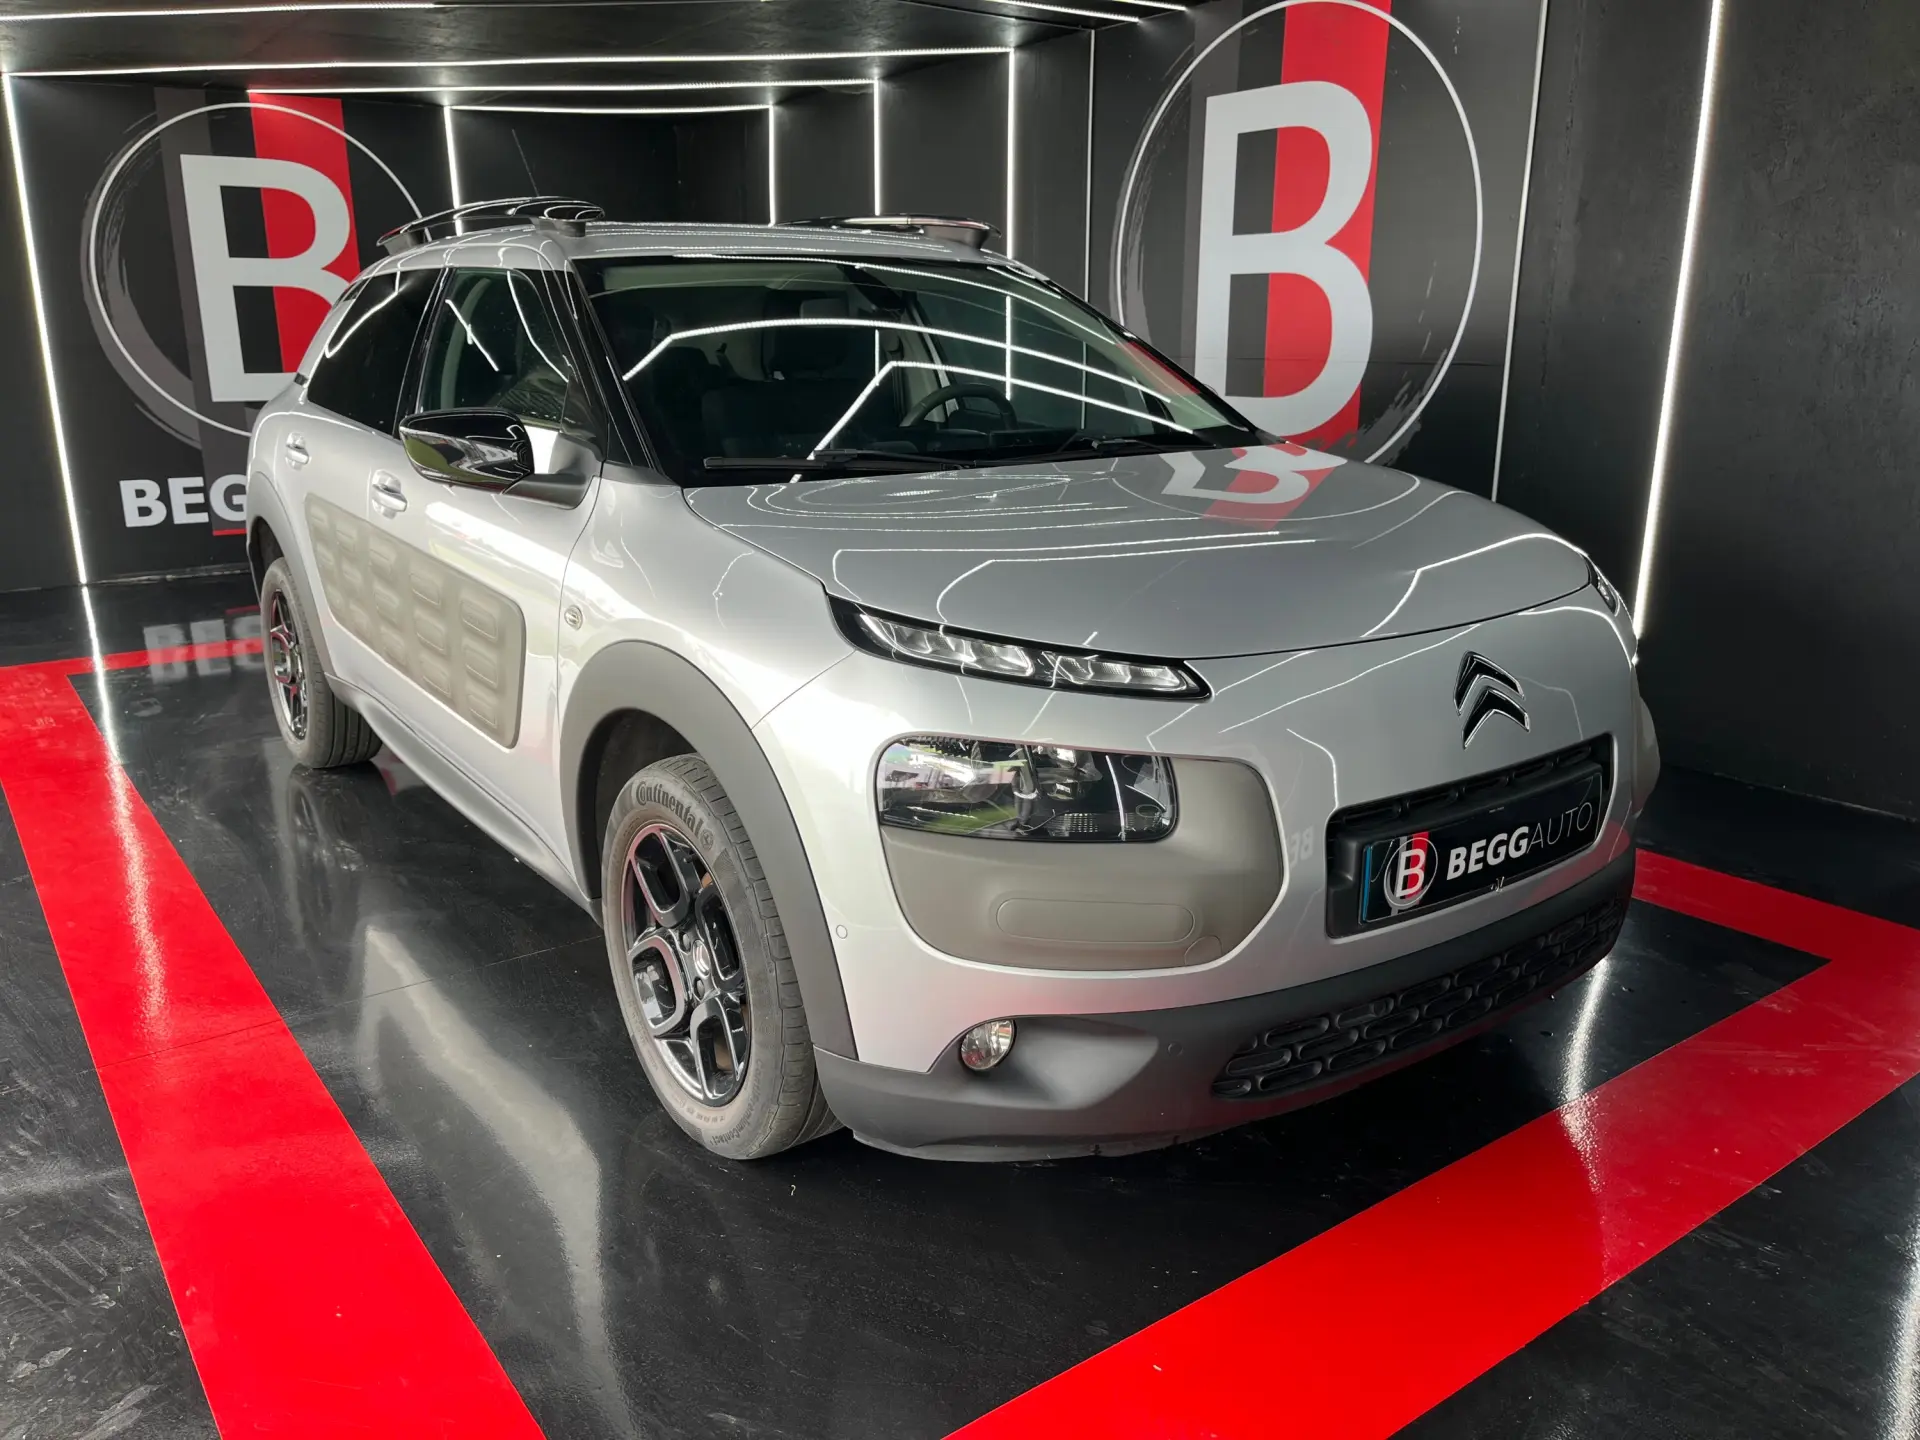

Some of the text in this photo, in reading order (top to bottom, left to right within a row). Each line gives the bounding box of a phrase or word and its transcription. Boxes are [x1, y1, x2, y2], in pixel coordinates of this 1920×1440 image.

[180, 153, 351, 402] B
[1192, 80, 1374, 438] B
[636, 781, 704, 839] Continental
[1395, 848, 1426, 898] B
